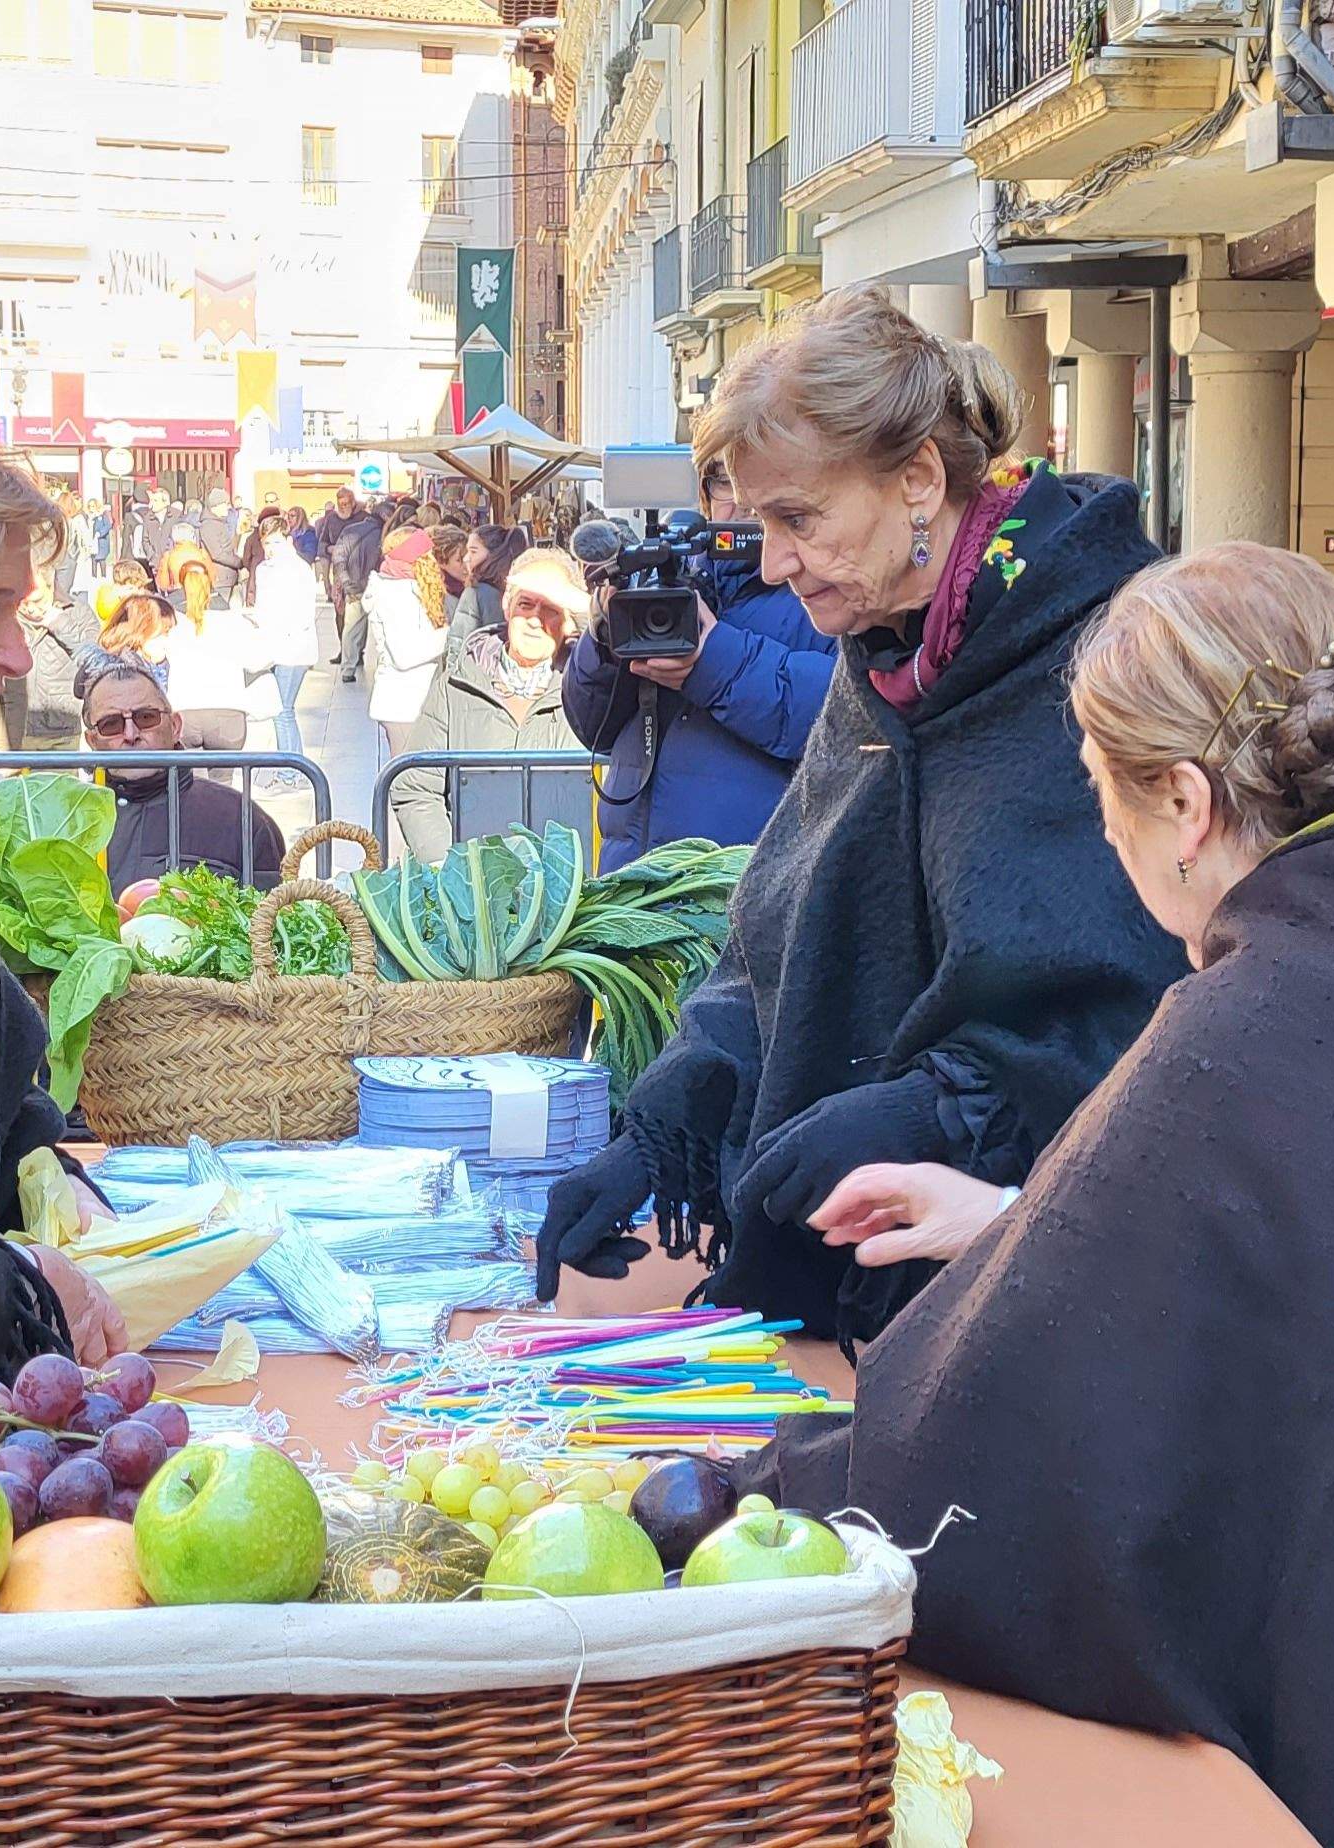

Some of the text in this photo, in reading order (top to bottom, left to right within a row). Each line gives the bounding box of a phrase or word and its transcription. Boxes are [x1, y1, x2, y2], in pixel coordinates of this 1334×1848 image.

[736, 532, 764, 541] ARAGÓ
[736, 541, 747, 549] TV
[644, 715, 653, 756] SONY
